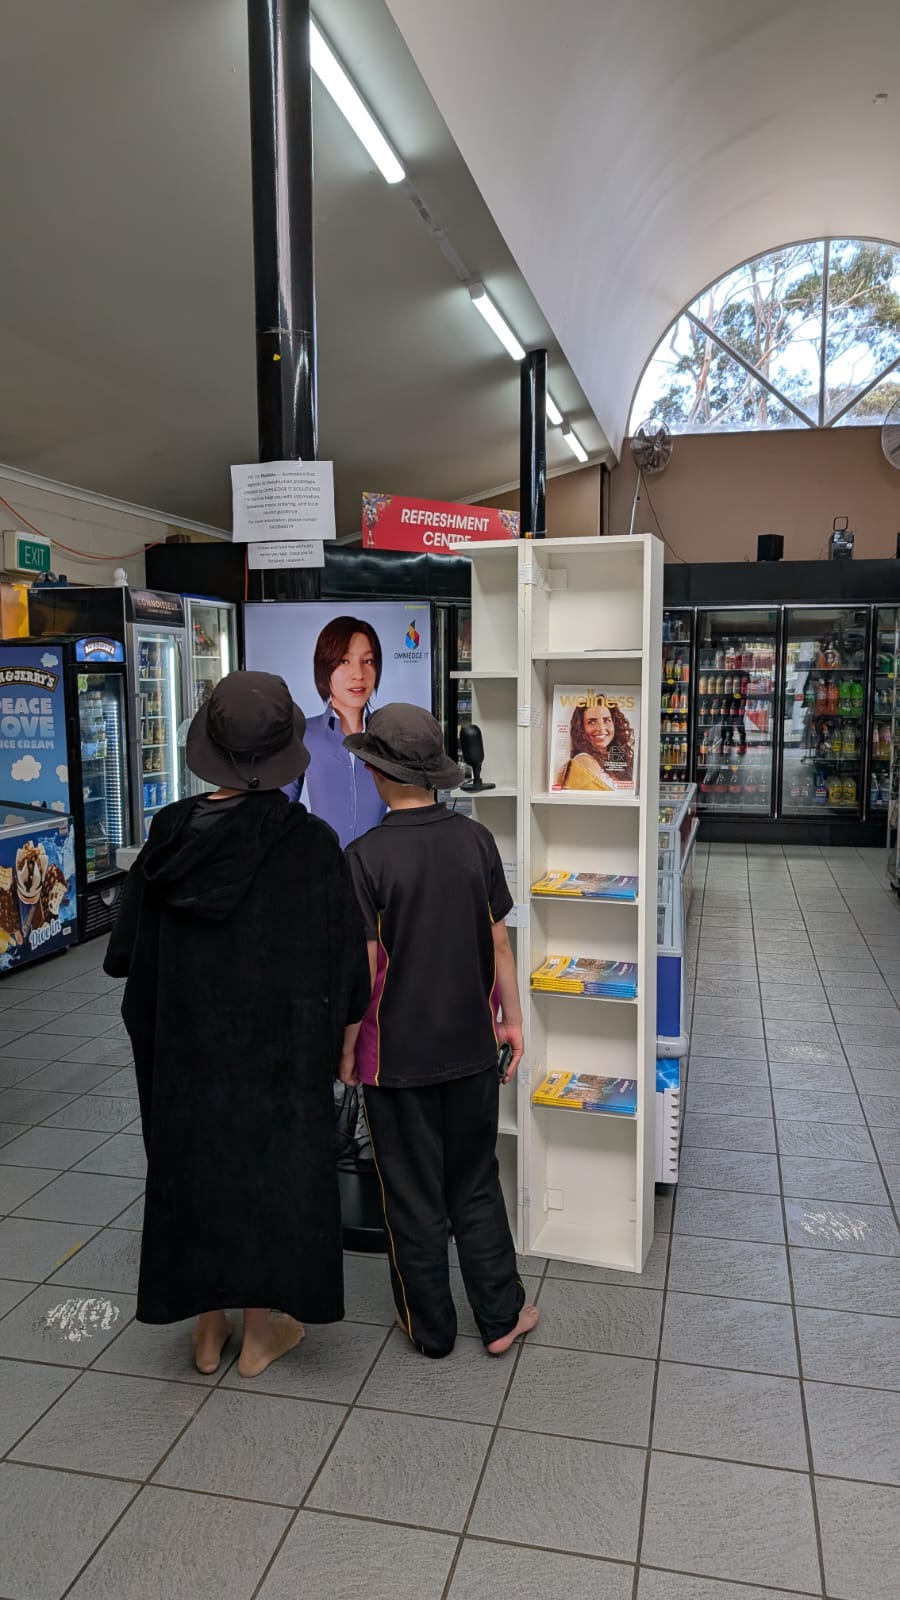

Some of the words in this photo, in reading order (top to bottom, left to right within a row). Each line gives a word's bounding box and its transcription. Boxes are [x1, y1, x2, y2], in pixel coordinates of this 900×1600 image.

[401, 508, 490, 532] REFRESHMENT
[24, 545, 46, 567] EXIT
[423, 652, 429, 660] IT
[0, 697, 53, 715] EACE
[560, 688, 635, 708] wellness
[0, 716, 55, 738] OVE
[17, 739, 54, 750] CREAM
[607, 753, 625, 761] FOX
[28, 925, 51, 950] Dive
[50, 918, 62, 937] in
